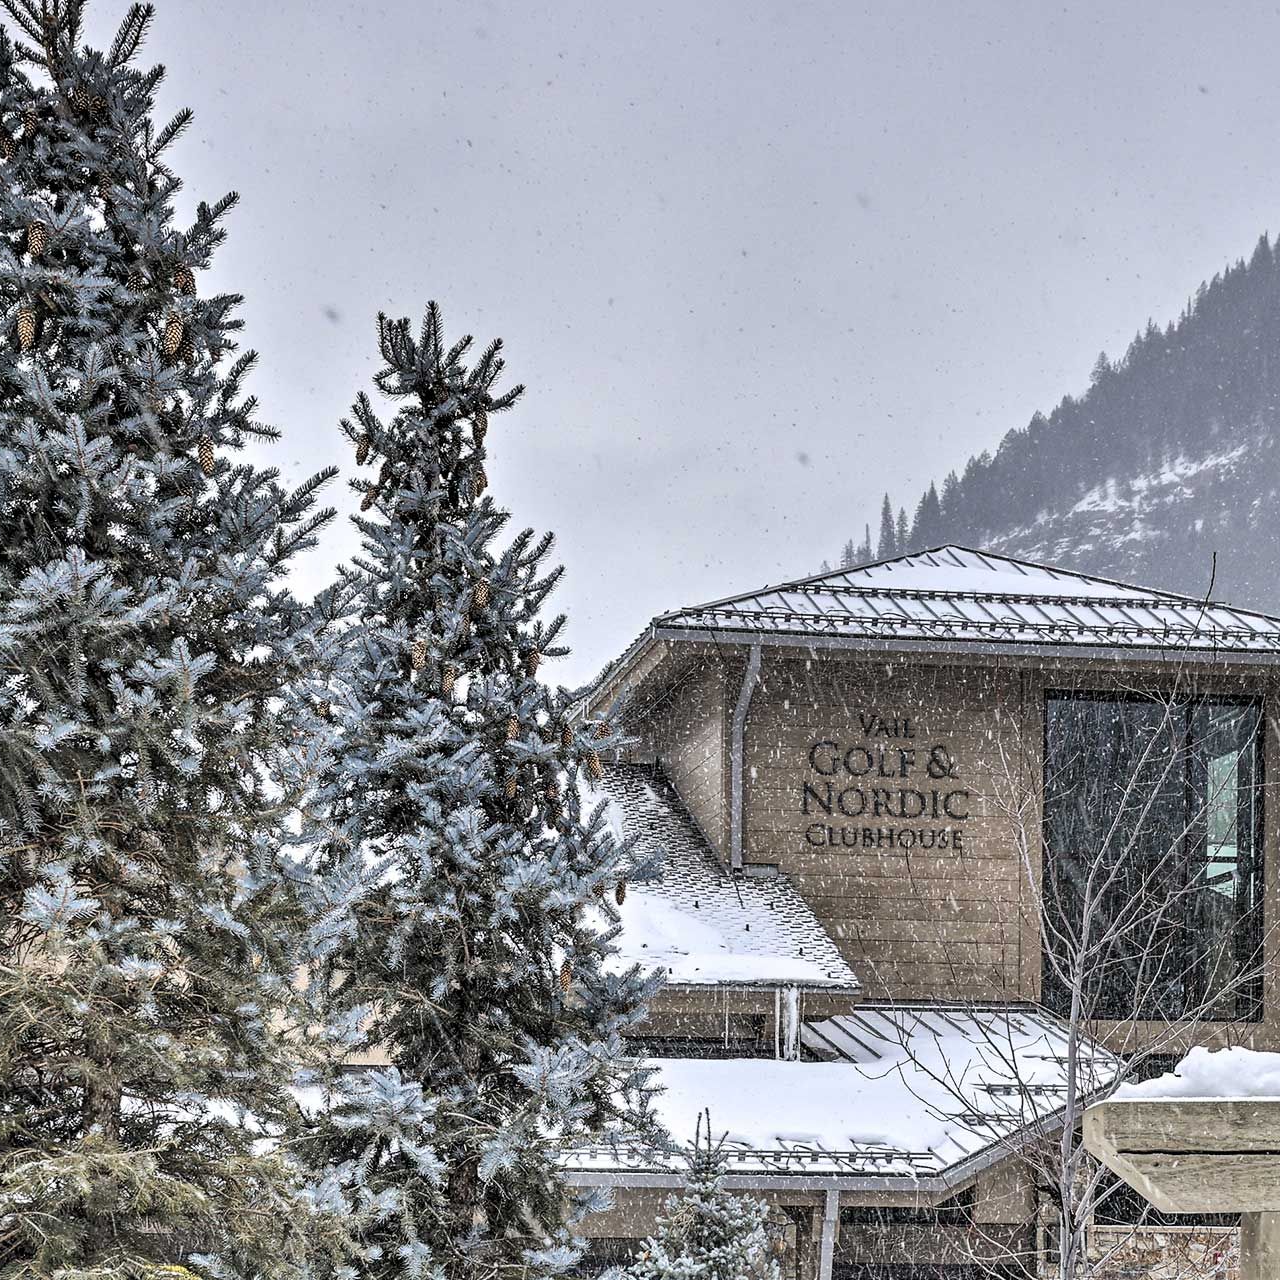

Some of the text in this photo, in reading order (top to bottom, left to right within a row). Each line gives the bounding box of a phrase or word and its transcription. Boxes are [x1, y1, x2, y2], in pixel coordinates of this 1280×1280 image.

[859, 713, 915, 739] VAIL
[808, 740, 959, 780] GOLF &
[801, 781, 969, 820] NORDIC
[805, 823, 963, 850] CLUBHOUSE
